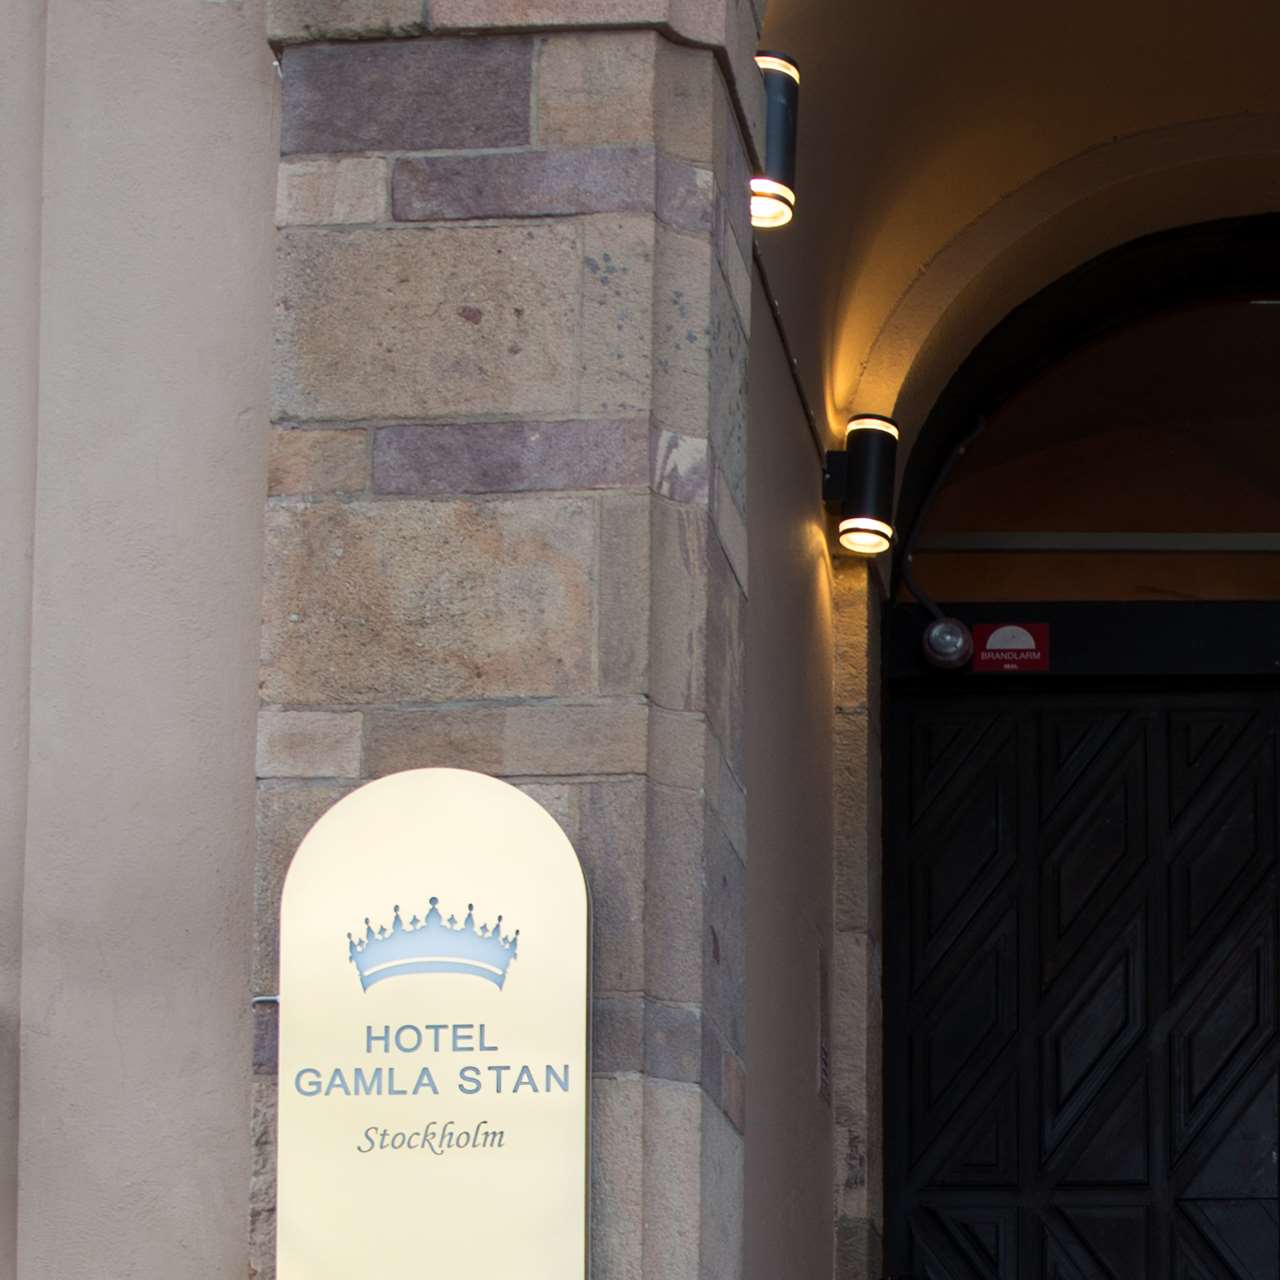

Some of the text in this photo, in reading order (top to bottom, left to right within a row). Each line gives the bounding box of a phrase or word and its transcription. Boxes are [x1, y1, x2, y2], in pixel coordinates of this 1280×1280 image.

[980, 650, 1041, 661] BRANDLARM
[365, 1024, 499, 1054] HOTEL
[294, 1064, 570, 1097] GAMLA STAN
[356, 1120, 505, 1156] Stockholm
